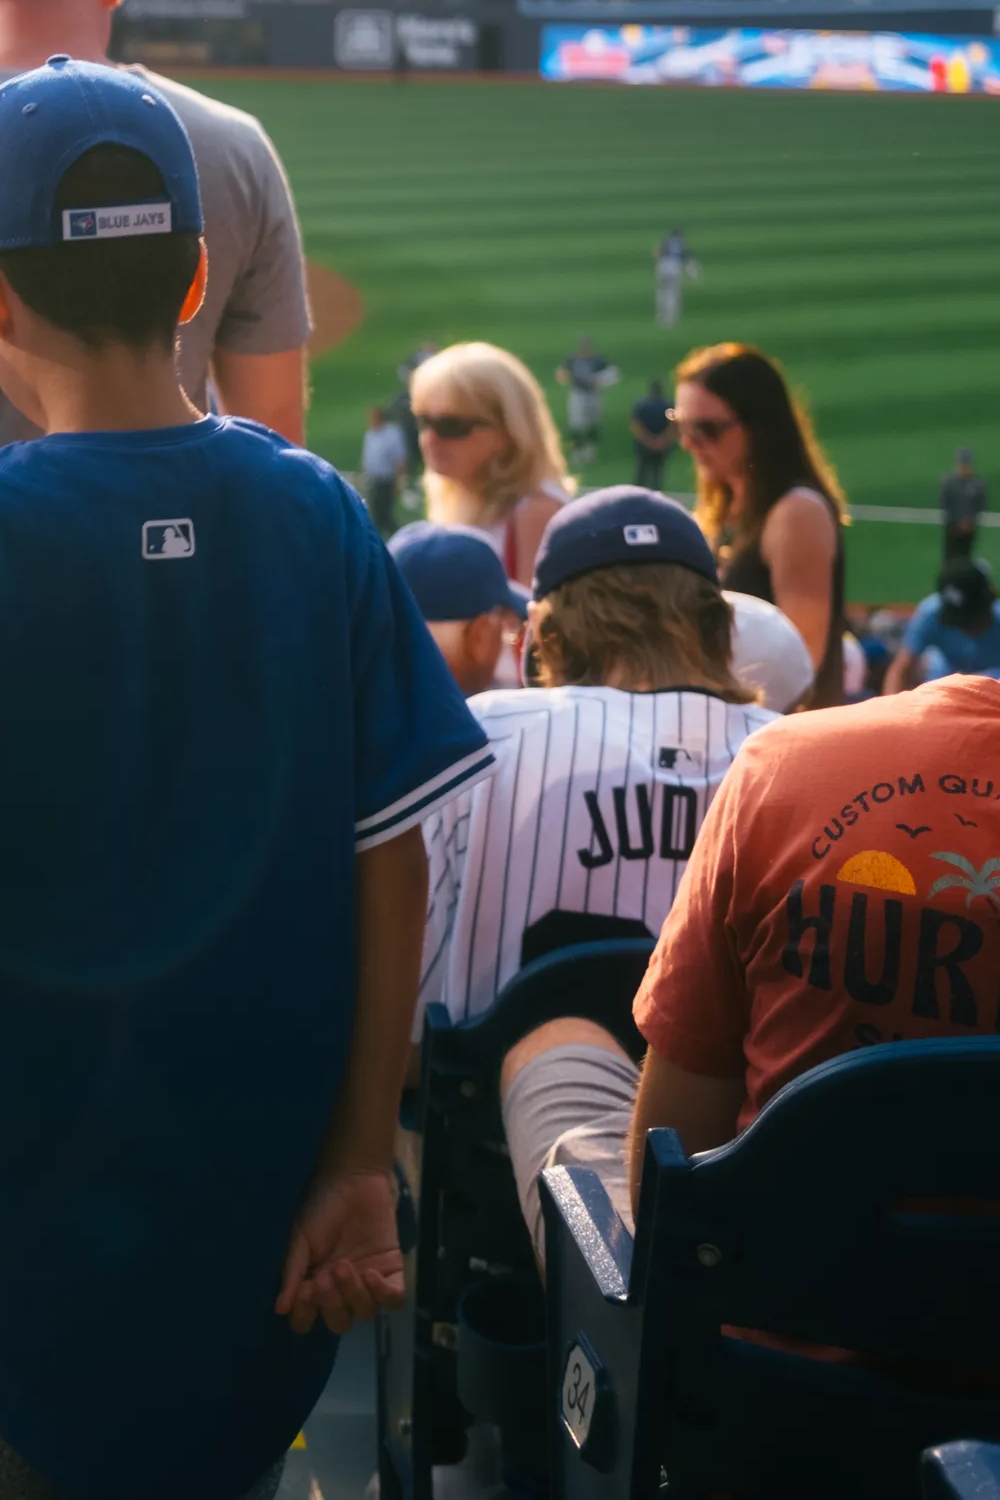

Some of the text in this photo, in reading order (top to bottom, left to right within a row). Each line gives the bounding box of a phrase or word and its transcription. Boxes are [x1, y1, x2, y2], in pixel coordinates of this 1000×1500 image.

[98, 212, 166, 230] BLUE JAYS
[811, 773, 1000, 860] CUSTOM QU
[780, 878, 1000, 1033] HUR
[567, 1362, 591, 1426] 34
